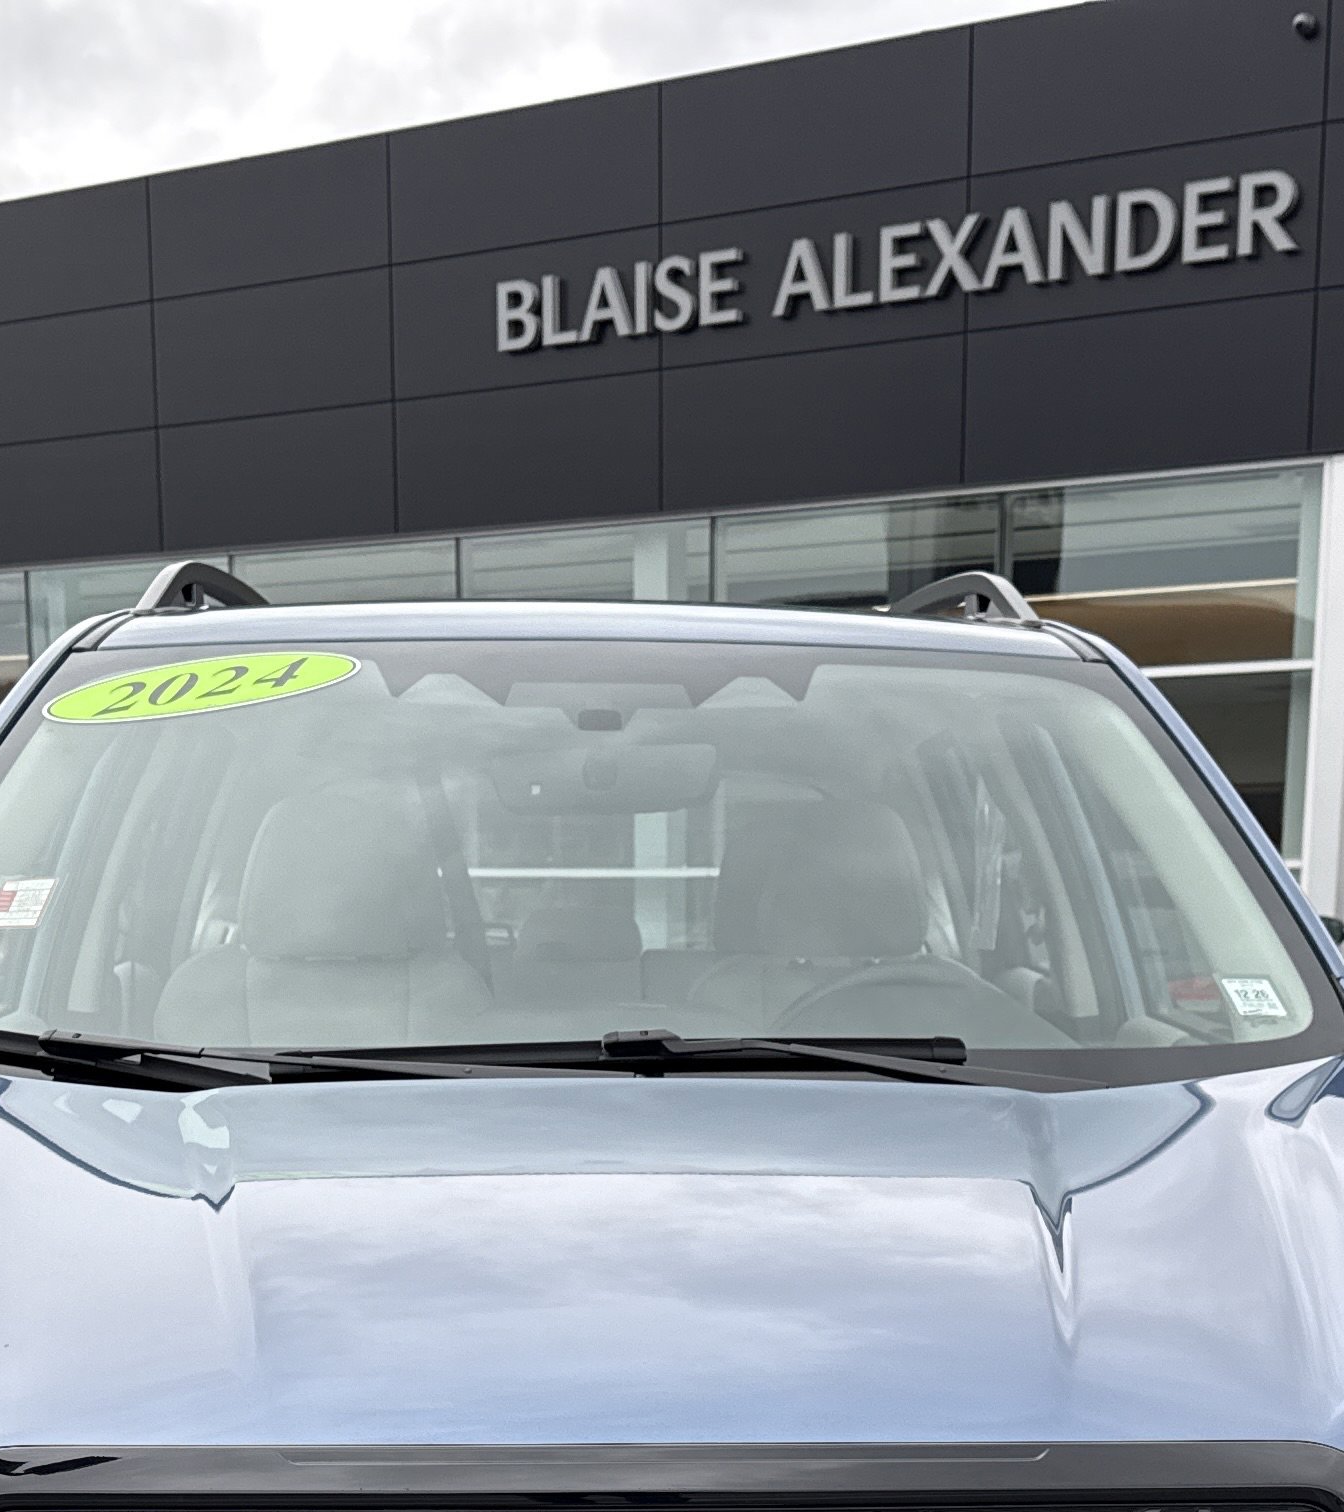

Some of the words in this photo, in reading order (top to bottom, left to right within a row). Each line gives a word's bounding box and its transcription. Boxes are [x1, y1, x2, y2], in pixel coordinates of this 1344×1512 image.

[495, 248, 744, 354] BLAISE
[771, 169, 1300, 319] ALEXANDER
[91, 656, 309, 717] 2024
